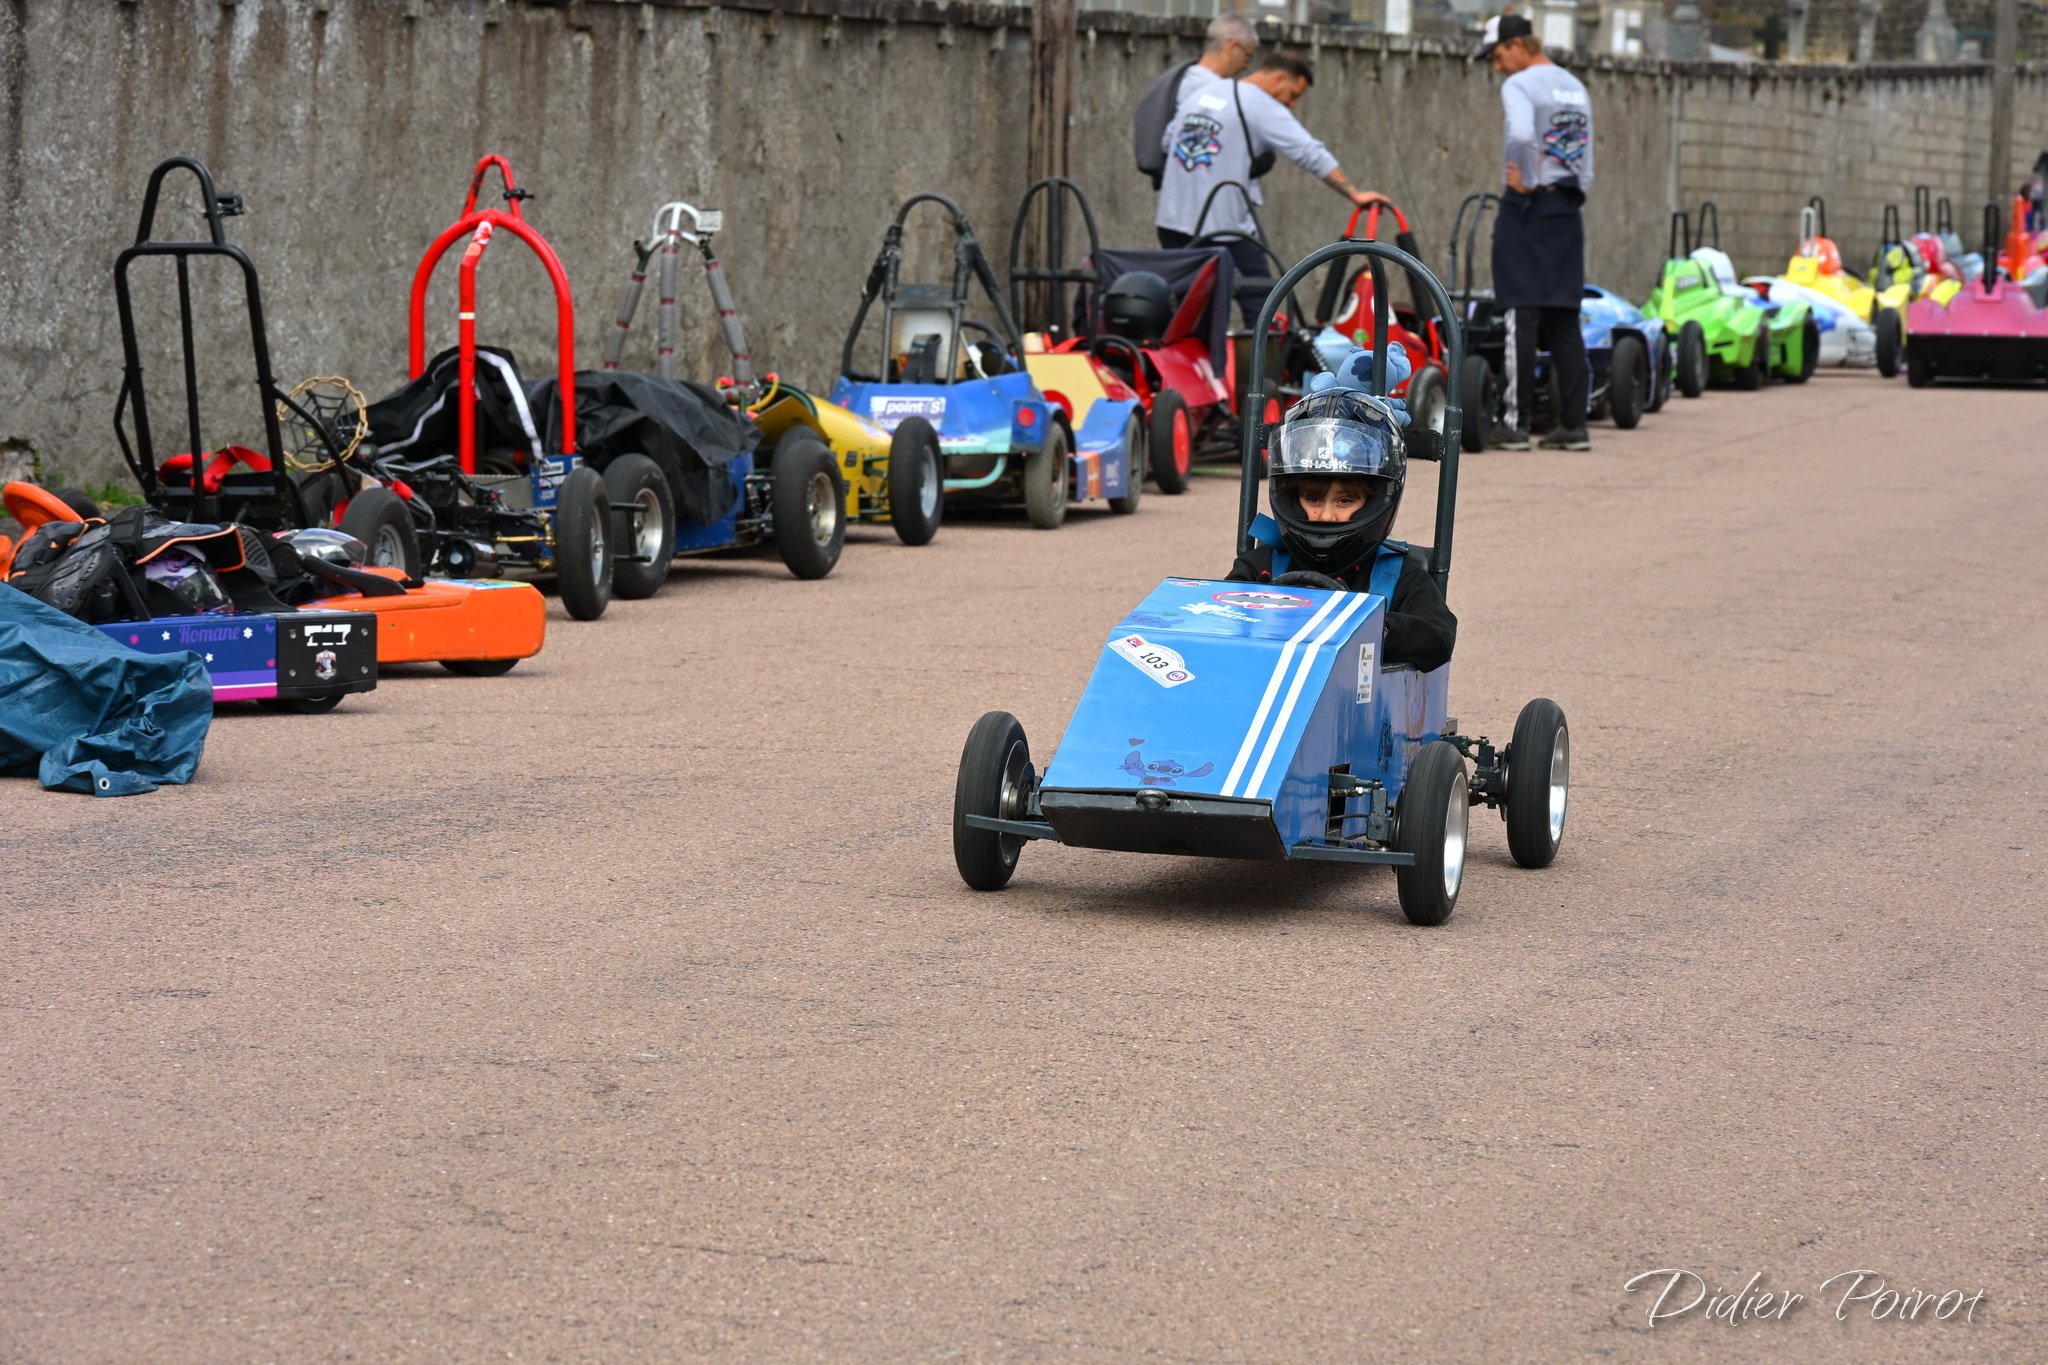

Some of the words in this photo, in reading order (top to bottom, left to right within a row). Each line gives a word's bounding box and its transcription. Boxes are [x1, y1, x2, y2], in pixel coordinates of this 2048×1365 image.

[887, 401, 923, 415] point
[1300, 459, 1348, 469] SHARK
[179, 624, 241, 644] Romane
[1140, 652, 1169, 669] 103
